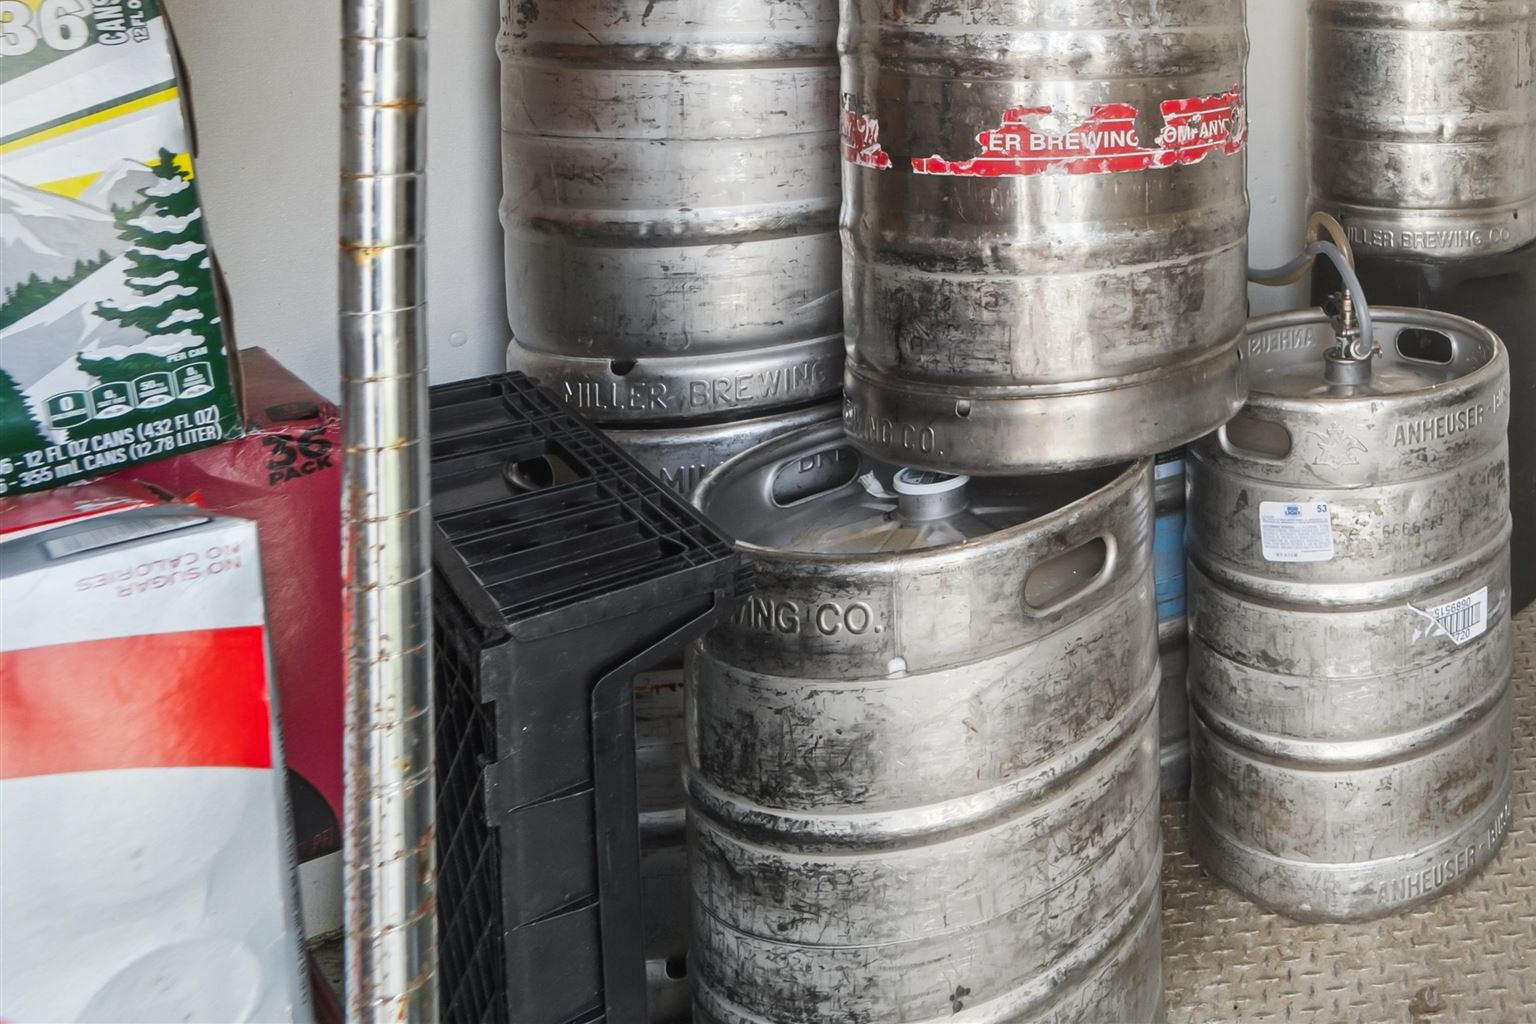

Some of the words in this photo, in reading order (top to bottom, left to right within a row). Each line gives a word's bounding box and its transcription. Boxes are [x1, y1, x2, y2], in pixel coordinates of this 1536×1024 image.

[130, 6, 146, 26] FL
[1401, 228, 1482, 249] BREWING
[564, 381, 669, 412] MILLER
[689, 360, 827, 408] BREWING
[59, 396, 74, 412] 0
[23, 449, 46, 468] 12
[46, 444, 68, 463] FL
[69, 439, 91, 457] OZ
[91, 428, 136, 452] CANS
[137, 419, 173, 443] (432
[174, 414, 195, 433] FL
[196, 405, 221, 425] OZ)
[903, 423, 944, 456] CO.
[1393, 403, 1485, 447] ANHEUSER
[18, 466, 54, 488] 355
[55, 459, 84, 478] mL
[84, 448, 128, 471] CANS
[129, 436, 176, 462] (12.78
[176, 422, 223, 450] LITER)
[262, 427, 333, 470] 36
[269, 456, 334, 486] PACK
[205, 543, 241, 559] NO
[208, 556, 241, 576] NO
[75, 550, 199, 593] CALORIES
[116, 565, 203, 599] SUGAR
[816, 601, 884, 636] CO.
[1377, 843, 1477, 905] ANHEUSER
